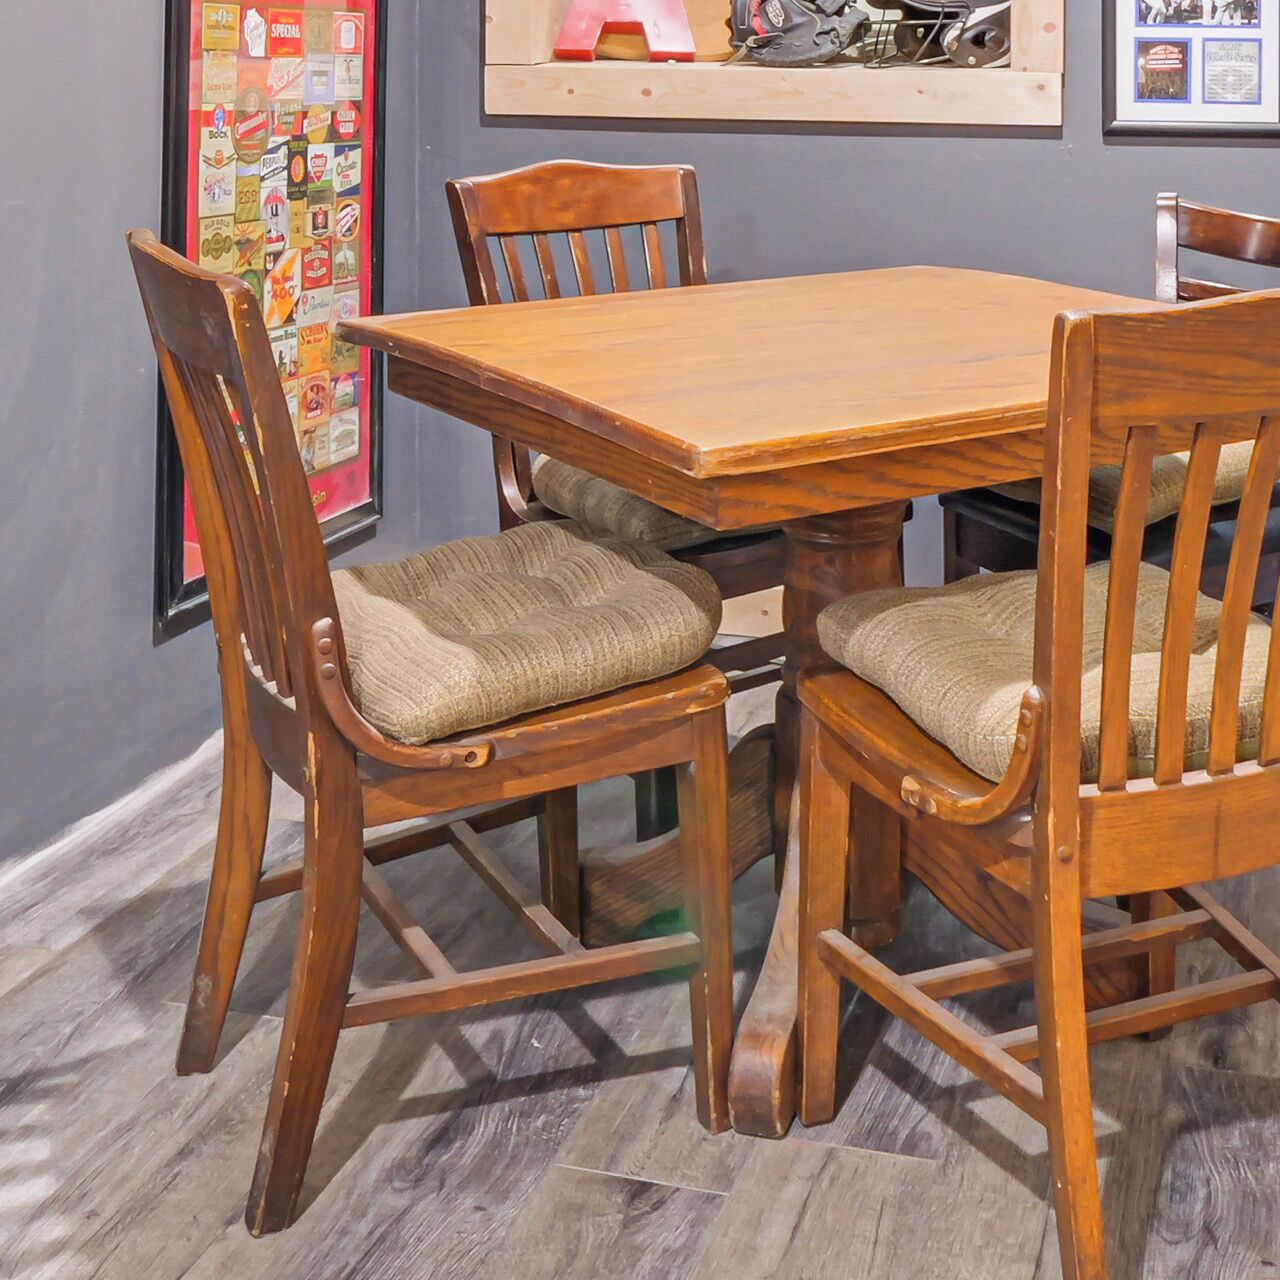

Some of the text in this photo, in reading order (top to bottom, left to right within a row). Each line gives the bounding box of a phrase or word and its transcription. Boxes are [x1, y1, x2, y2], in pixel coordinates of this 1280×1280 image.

[271, 23, 301, 38] SPECIAL
[209, 130, 228, 140] BOCK
[204, 219, 230, 231] OLD GOLD
